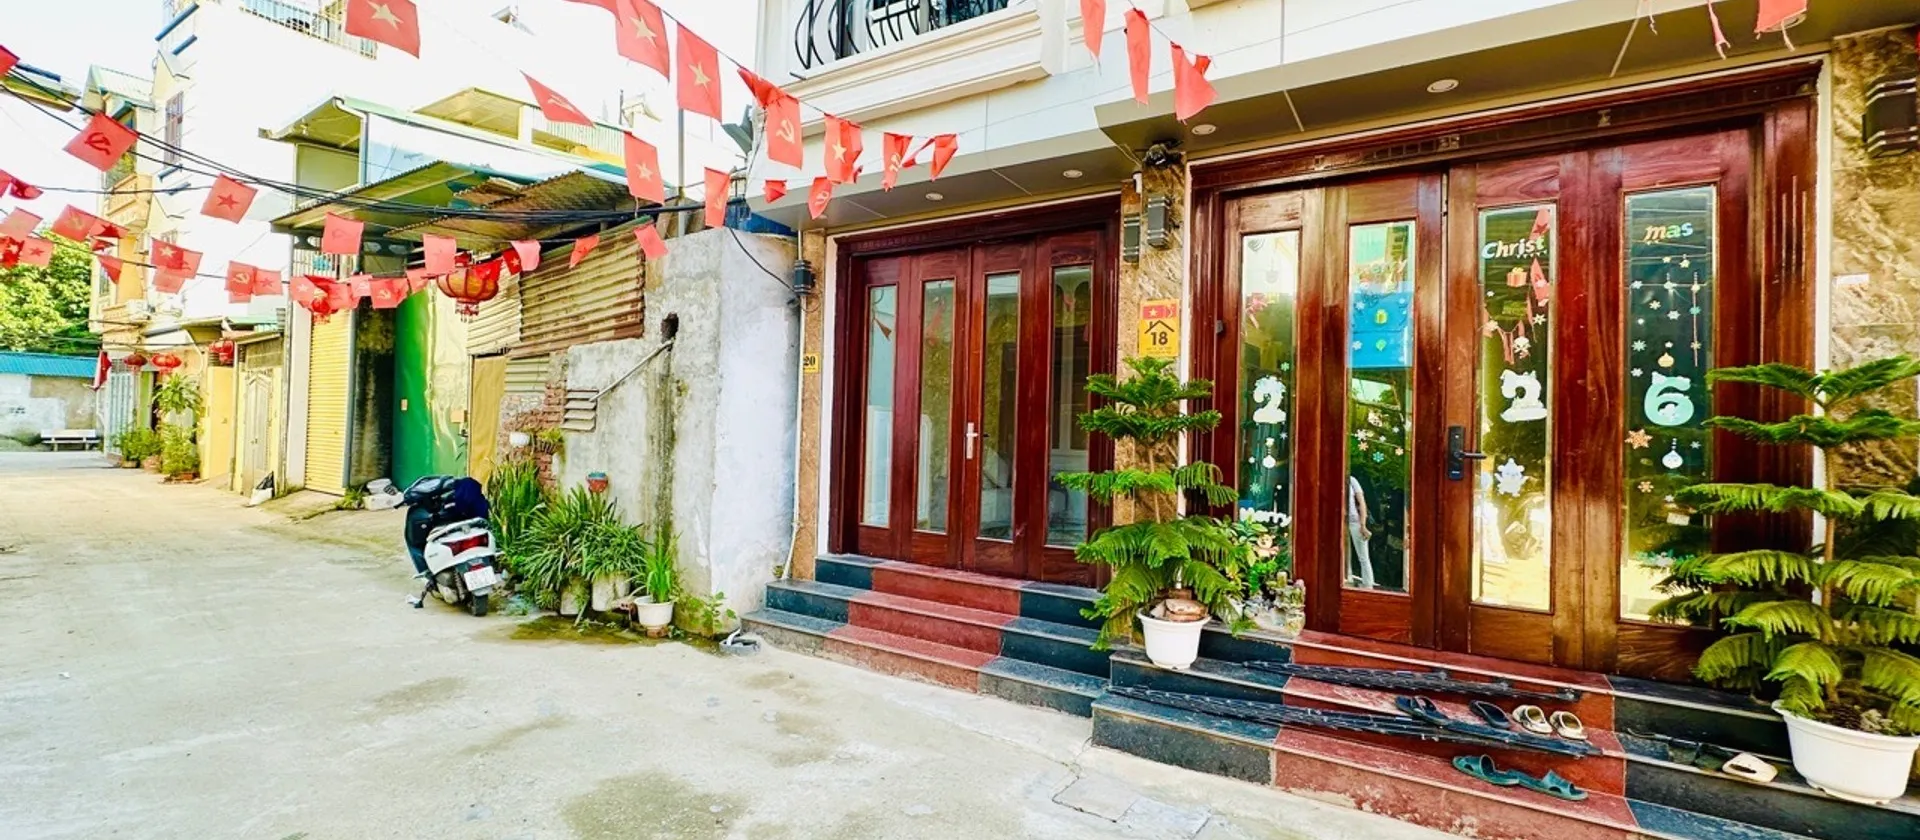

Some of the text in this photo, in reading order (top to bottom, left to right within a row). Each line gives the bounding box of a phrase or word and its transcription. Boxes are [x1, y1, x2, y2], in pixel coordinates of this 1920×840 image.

[1481, 235, 1545, 259] Christ
[1643, 222, 1694, 241] mas
[1150, 331, 1168, 346] 18
[803, 355, 816, 367] 20
[1253, 370, 1695, 426] 2 2 6
